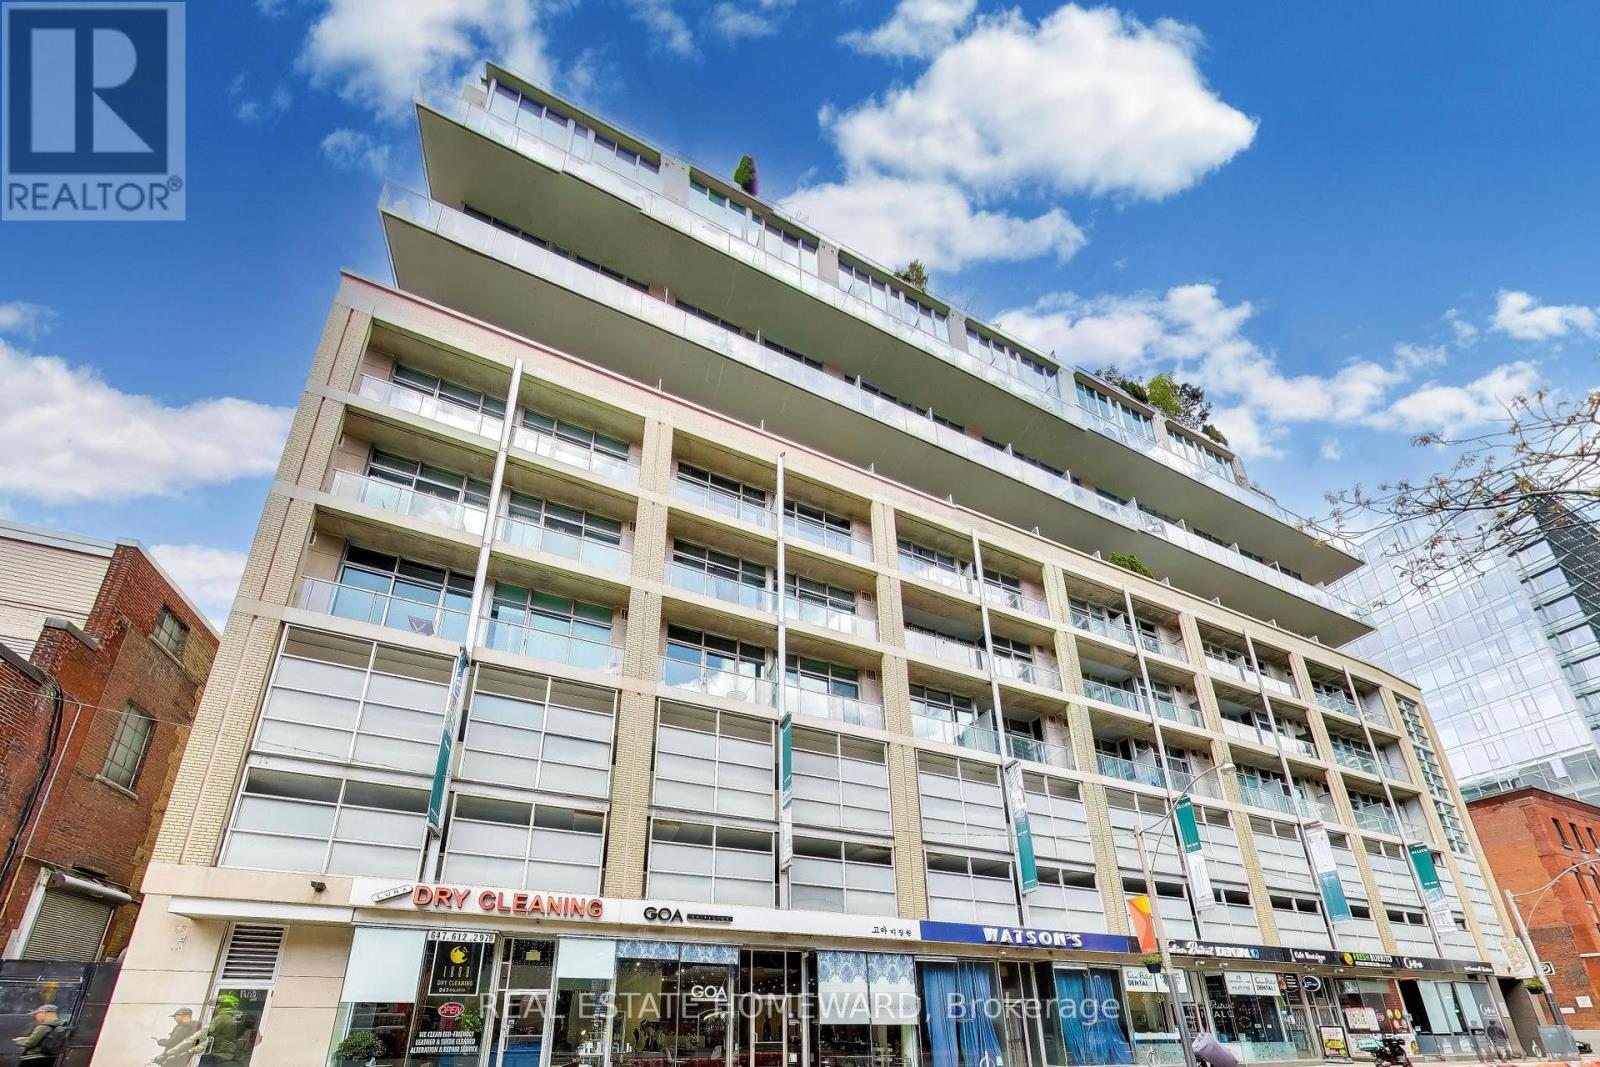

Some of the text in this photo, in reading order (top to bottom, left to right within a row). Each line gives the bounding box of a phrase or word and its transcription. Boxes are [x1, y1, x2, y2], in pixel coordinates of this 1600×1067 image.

[413, 885, 604, 918] DRY CLEANING
[643, 906, 684, 924] GOA
[983, 927, 1083, 949] WATSON'S
[1127, 979, 1149, 987] DENTAL
[691, 985, 728, 998] GOA
[441, 1005, 462, 1014] OPEN
[410, 1046, 439, 1054] ALTERATION
